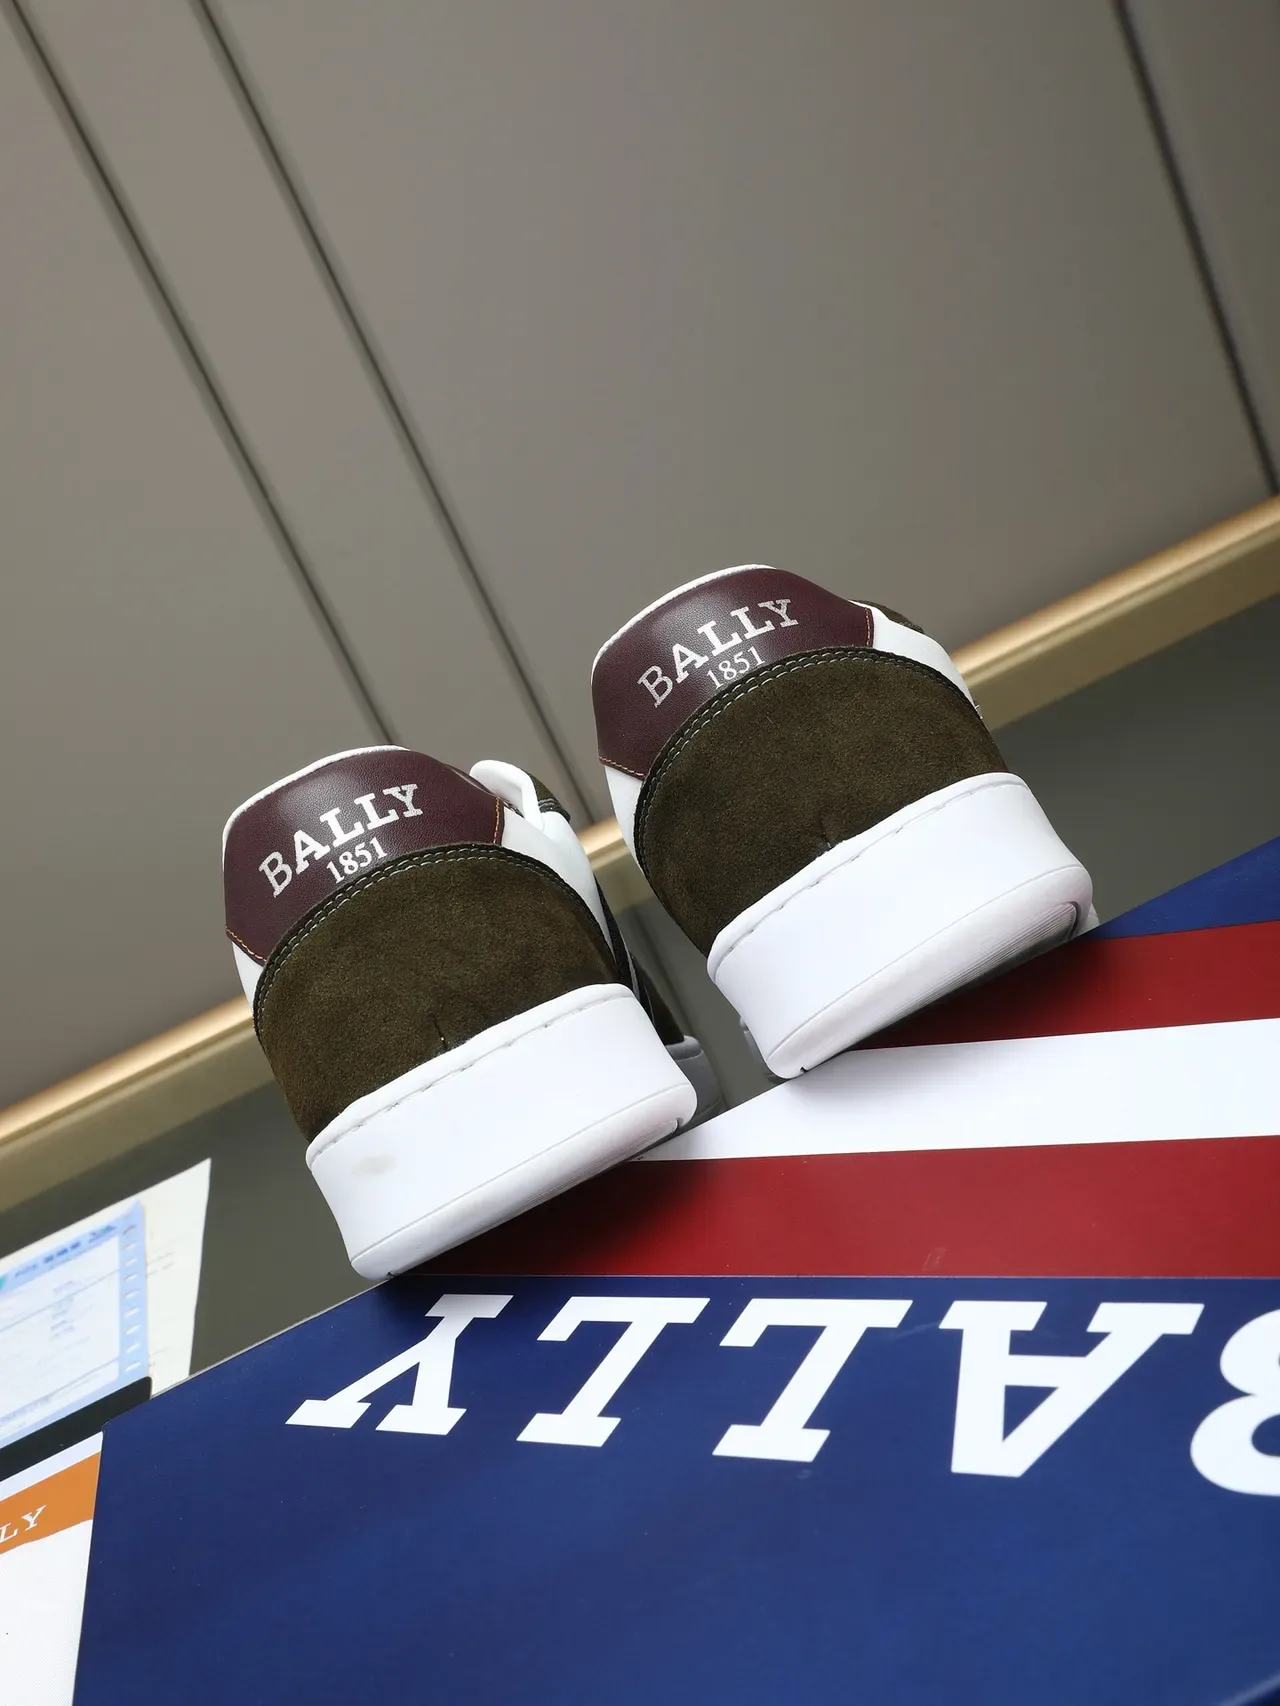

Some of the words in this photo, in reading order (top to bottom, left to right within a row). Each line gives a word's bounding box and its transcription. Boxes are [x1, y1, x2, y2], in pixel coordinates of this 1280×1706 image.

[637, 598, 799, 708] BALLY
[706, 646, 766, 690] 1851
[258, 783, 423, 898] BALLY
[326, 836, 388, 884] 1851
